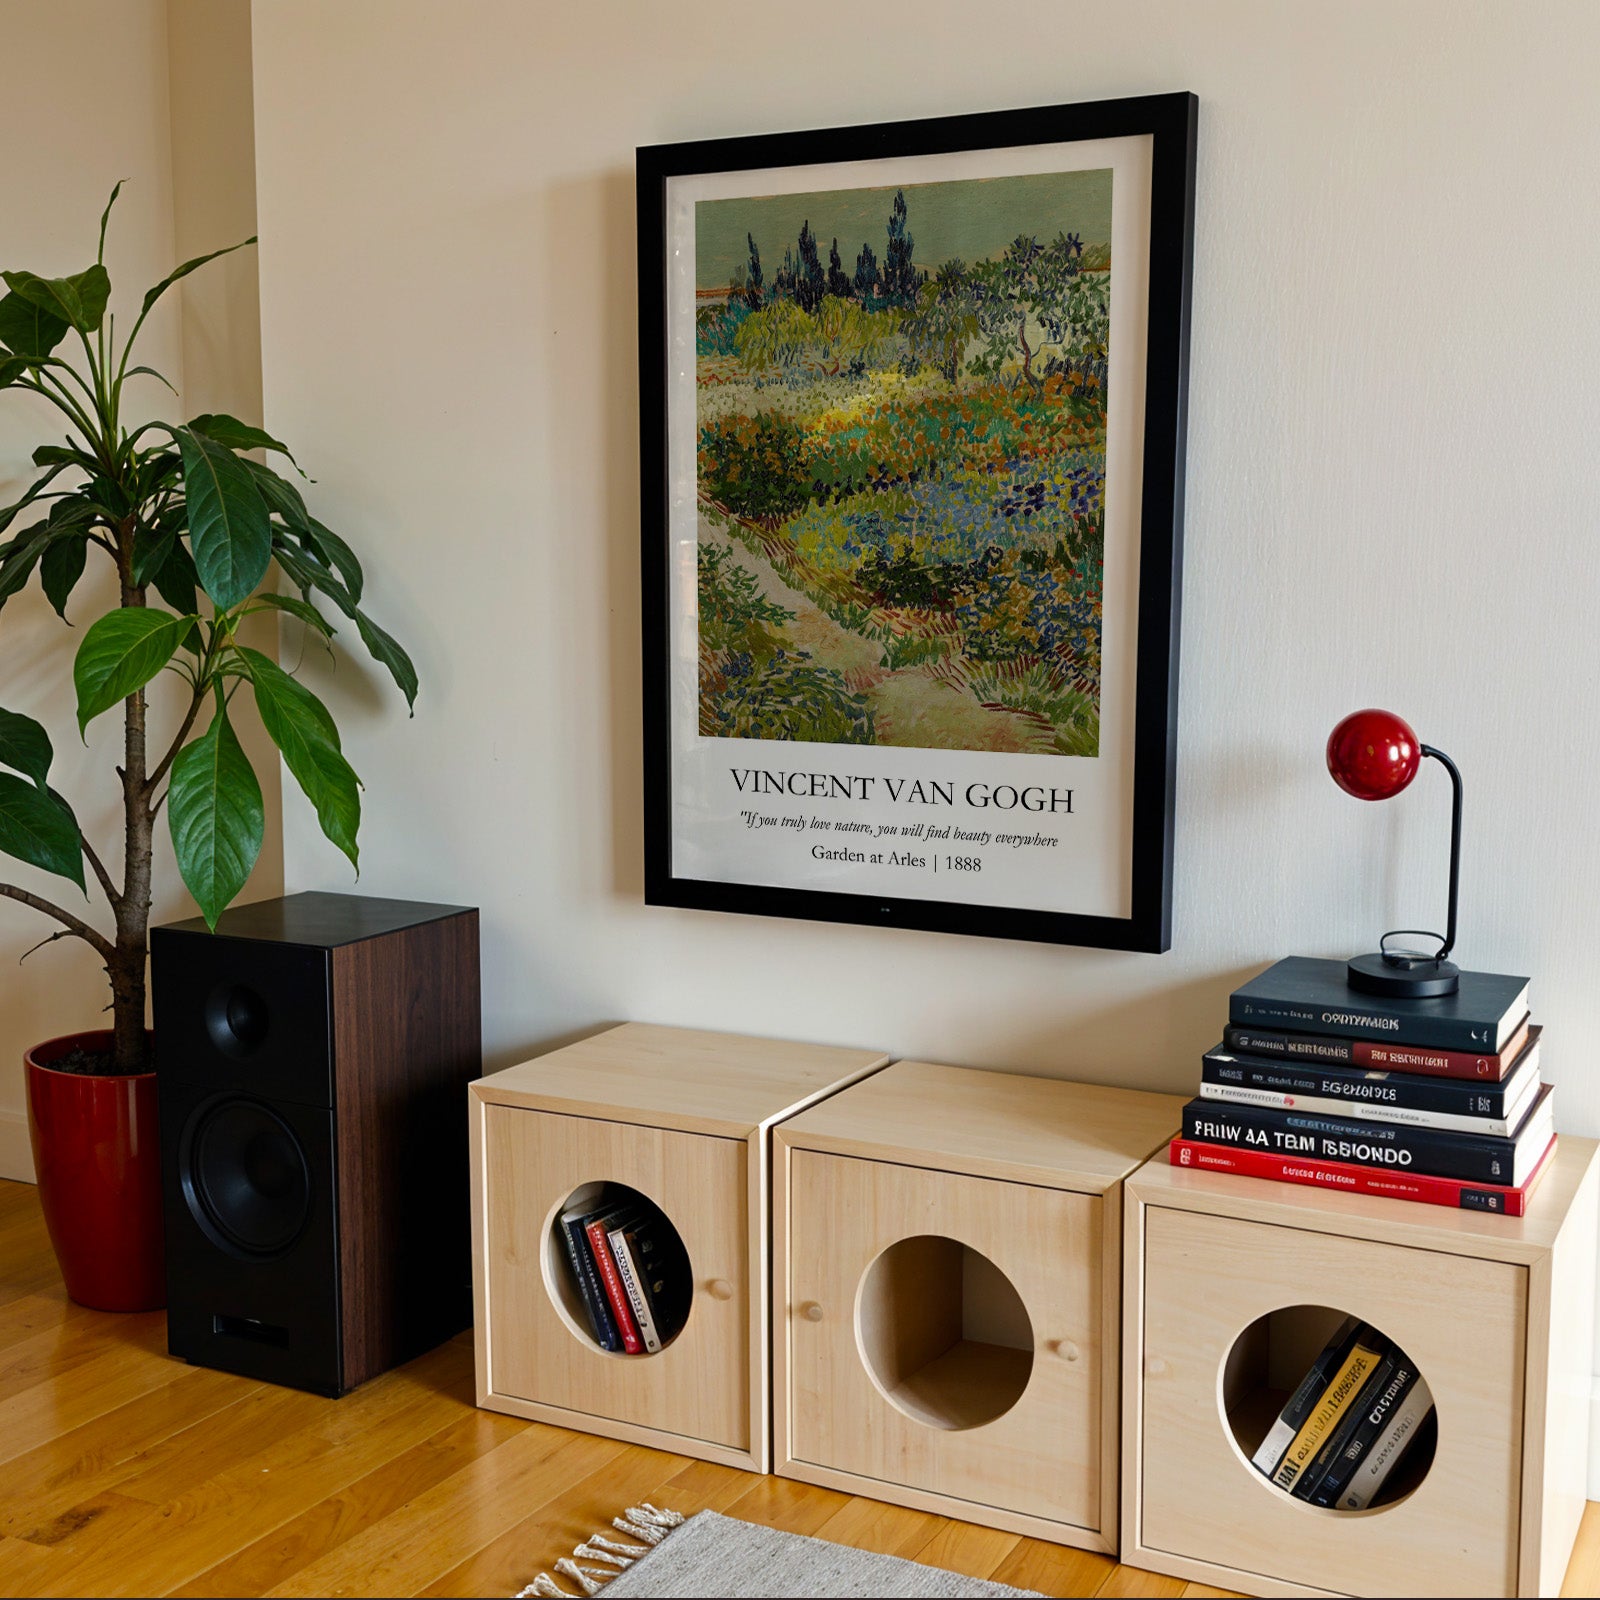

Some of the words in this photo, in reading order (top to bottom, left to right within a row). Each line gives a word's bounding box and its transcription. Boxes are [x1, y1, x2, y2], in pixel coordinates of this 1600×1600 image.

[729, 768, 875, 800] VINCENT
[883, 777, 955, 806] VAN
[965, 783, 1075, 813] GOGH
[755, 815, 778, 829] you
[781, 815, 807, 832] truly
[810, 816, 831, 830] love
[834, 819, 873, 834] nature,
[873, 825, 897, 838] you
[901, 824, 924, 837] will
[922, 825, 951, 842] find
[953, 827, 992, 846] beauty
[995, 832, 1059, 849] everywhere
[811, 845, 865, 863] Garden
[870, 853, 884, 864] at
[887, 851, 926, 868] Arles
[945, 855, 982, 873] 1888
